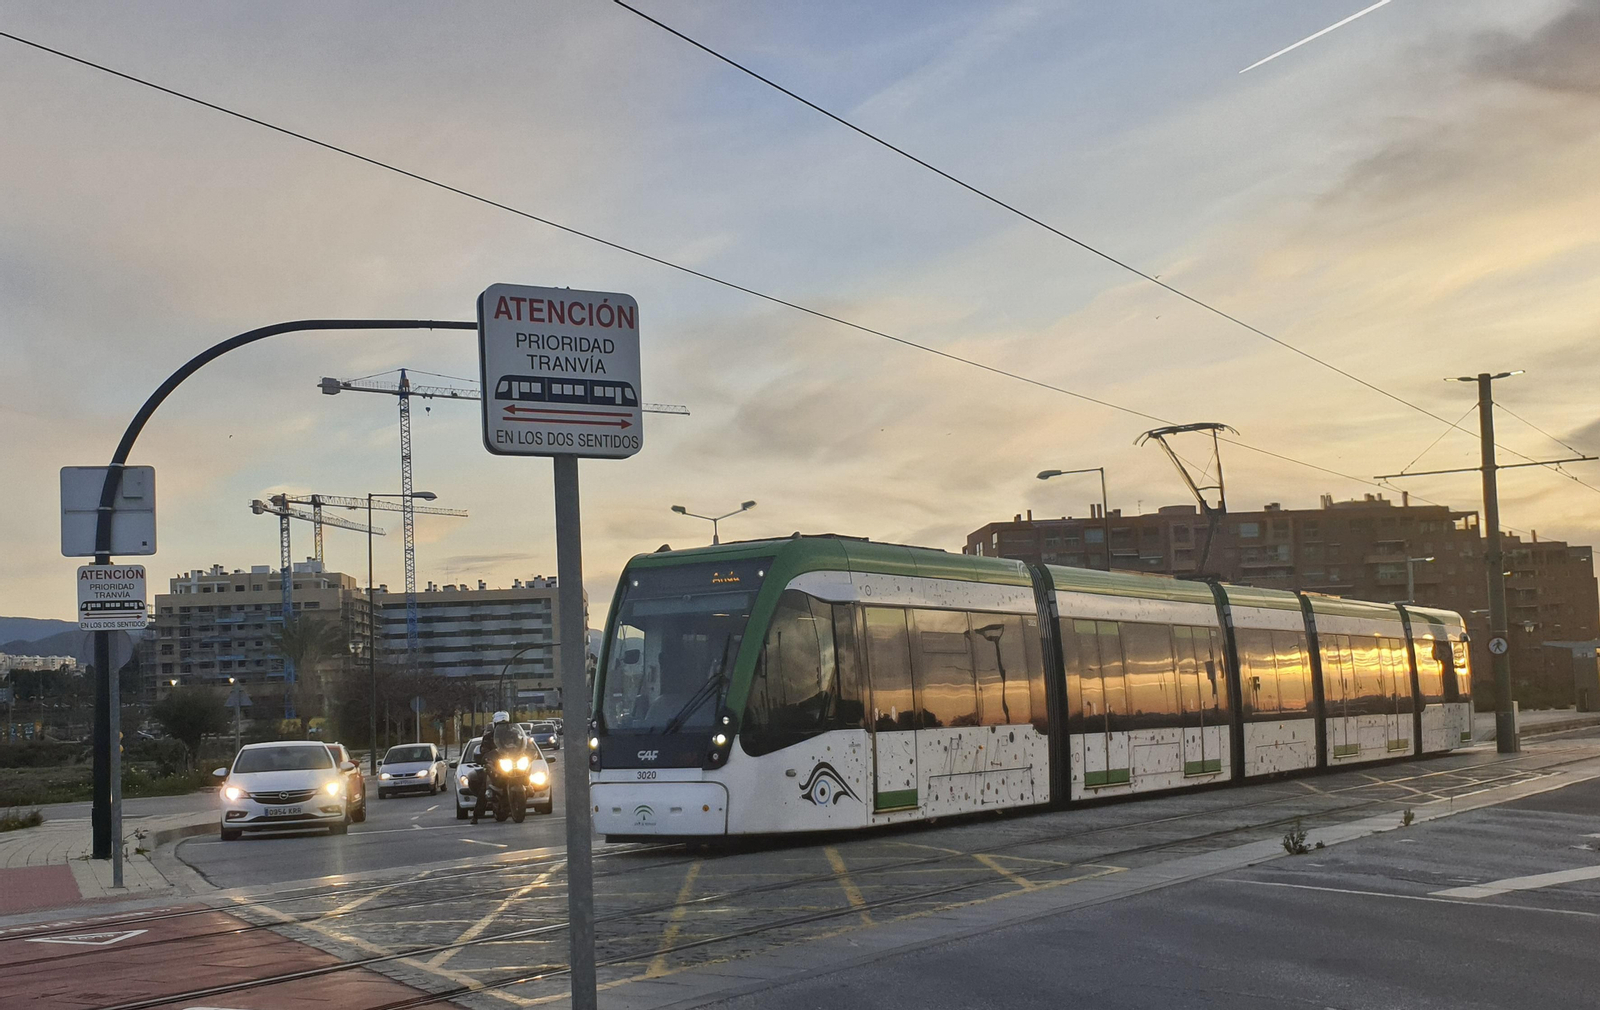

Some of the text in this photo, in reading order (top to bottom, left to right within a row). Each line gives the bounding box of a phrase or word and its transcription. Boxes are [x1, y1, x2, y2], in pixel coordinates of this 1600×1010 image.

[494, 295, 635, 329] ATENCIÓN
[516, 332, 615, 354] PRIORIDAD
[526, 354, 607, 374] TRANVÍA
[496, 429, 639, 450] EN LOS DOS SENTIDOS
[80, 567, 144, 580] ATENCIÓN
[90, 583, 135, 591] PRIORIDAD
[94, 591, 131, 599] TRANVÍA
[117, 620, 146, 628] SENTIDOS
[637, 750, 659, 761] CAF
[636, 770, 657, 780] 3020
